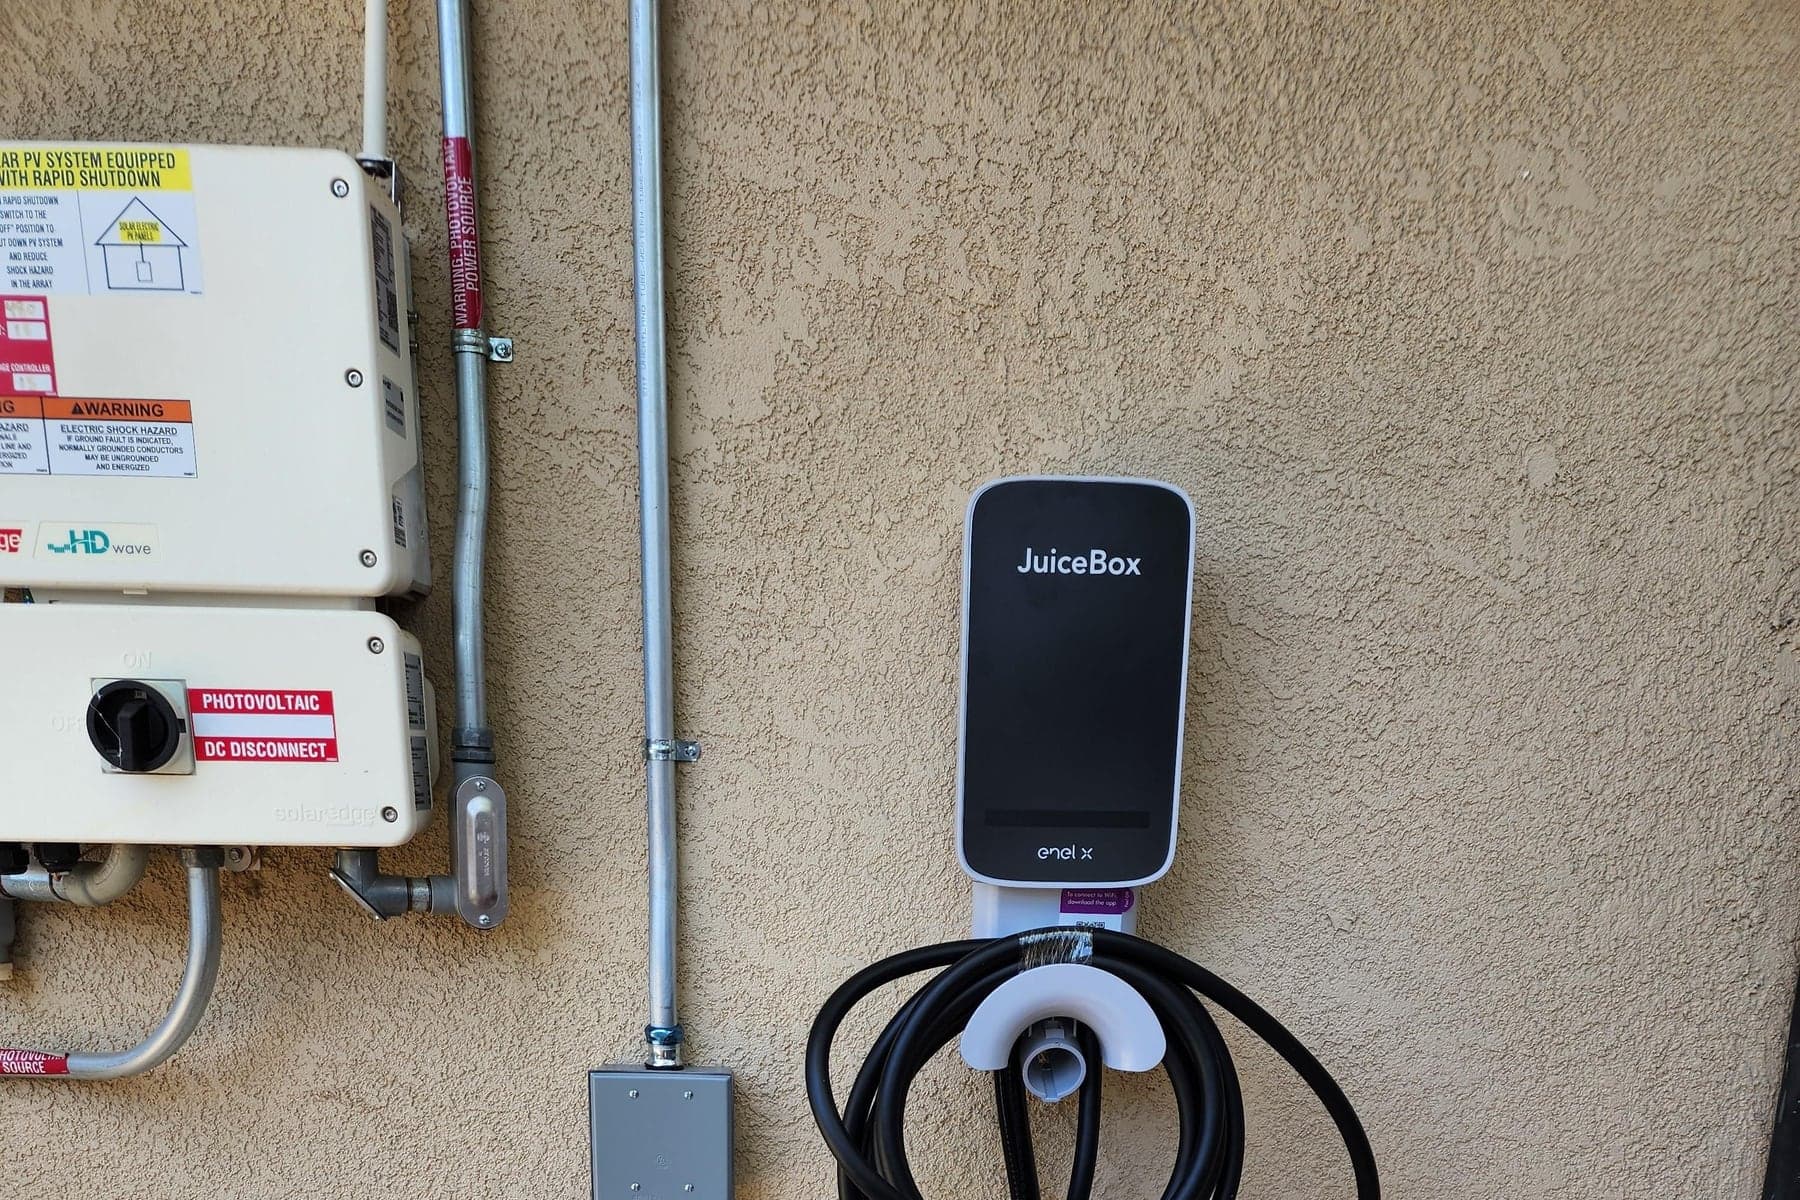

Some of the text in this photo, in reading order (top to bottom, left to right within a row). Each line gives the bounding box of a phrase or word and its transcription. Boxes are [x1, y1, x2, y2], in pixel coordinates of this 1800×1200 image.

[0, 152, 175, 169] AR PV SYSTEM EQUIPPED
[33, 170, 75, 186] RAPID
[80, 170, 161, 187] SHUTDOWN
[443, 138, 462, 249] PHOTOVOLTAIC
[3, 196, 58, 205] RAPID SHUTDOWN
[25, 210, 33, 219] TO
[35, 210, 46, 219] THE
[16, 224, 44, 233] POSITION
[46, 224, 54, 233] TO
[458, 176, 479, 291] POWER SOURCE
[8, 238, 63, 247] DOWN PV SYSTEM
[9, 252, 47, 261] AND REDUCE
[6, 266, 54, 275] SHOCK HAZARD
[11, 280, 53, 288] IN THE ARRAY
[10, 363, 51, 373] CONTROLLER
[84, 401, 164, 417] WARNING
[61, 424, 177, 435] ELECTRIC SHOCK HAZARD
[75, 435, 103, 443] GROUND
[105, 435, 126, 443] FAULT
[59, 444, 183, 454] NORMALLY GROUNDED CONDUCTORS
[69, 529, 151, 555] HD wave
[1017, 547, 1141, 576] JuiceBox
[202, 693, 320, 711] PHOTOVOLTAIC
[205, 741, 327, 758] DC DISCONNECT
[1038, 844, 1093, 860] enel x
[2, 1061, 46, 1074] SOURCE
